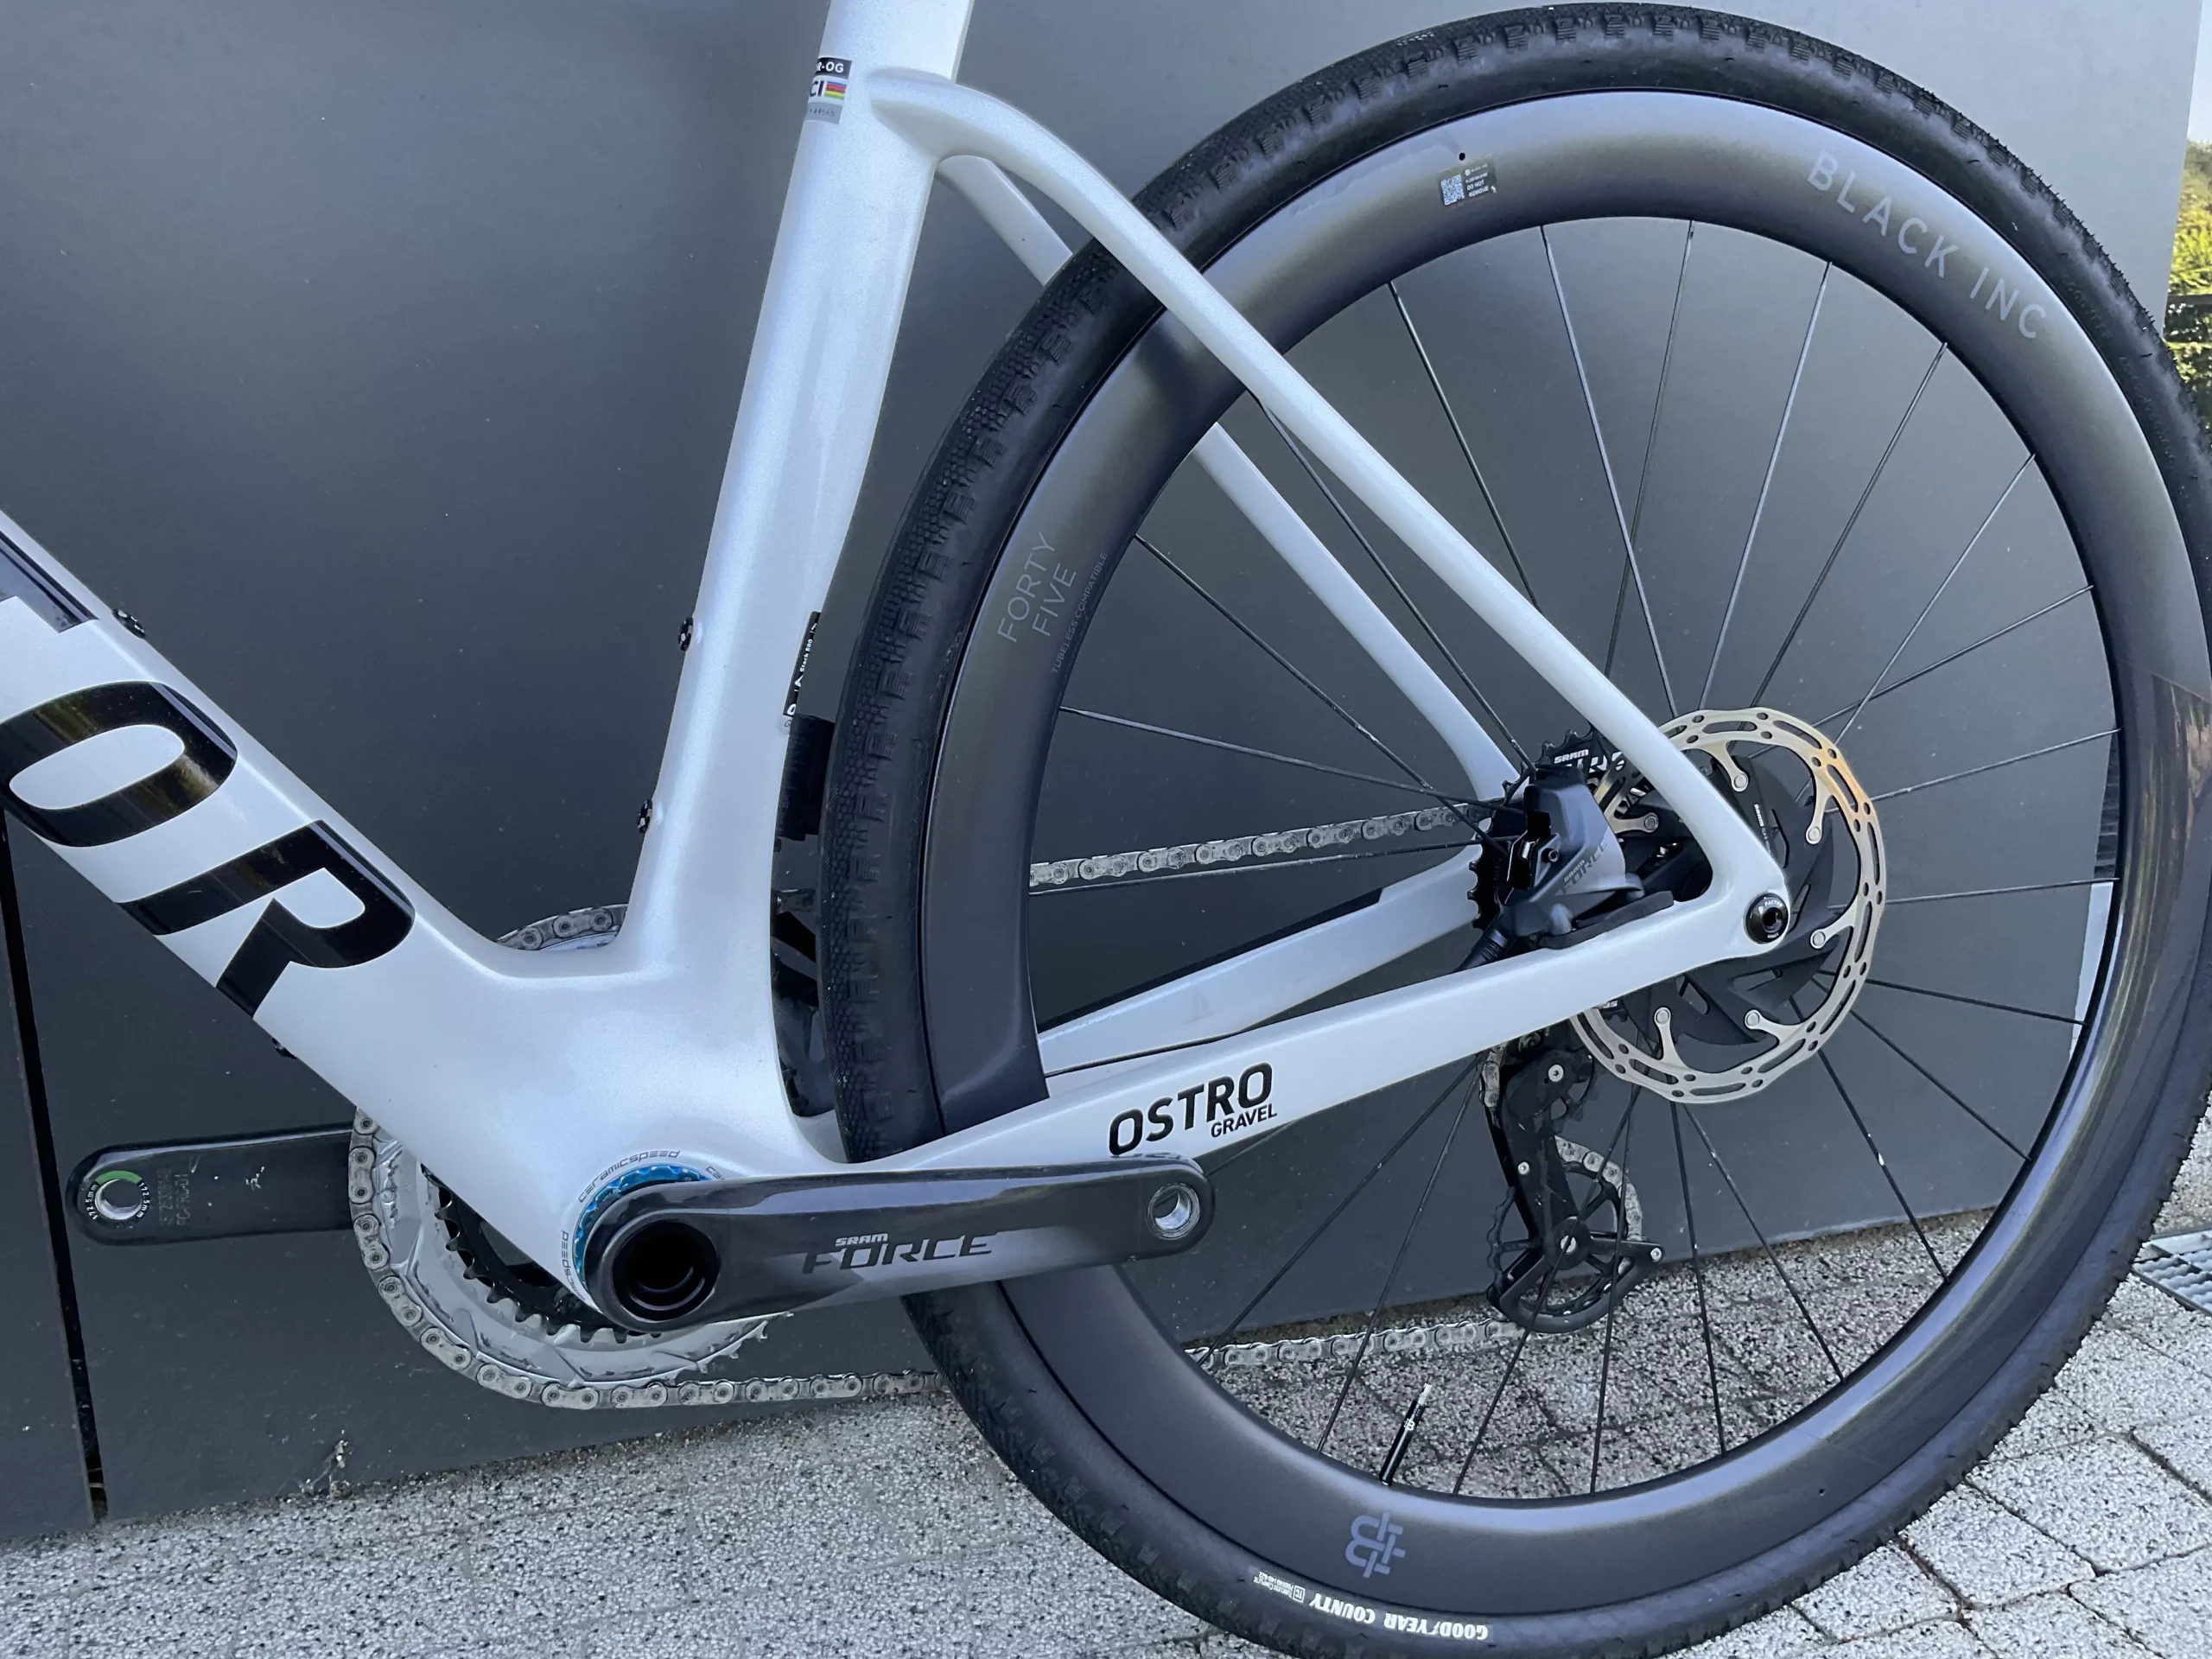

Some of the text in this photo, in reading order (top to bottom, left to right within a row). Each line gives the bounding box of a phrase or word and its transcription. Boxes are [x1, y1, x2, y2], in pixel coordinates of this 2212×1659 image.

[1808, 149, 2046, 339] BLACK INC
[997, 531, 1055, 643] FORTY
[1032, 563, 1077, 637] FIVE
[1052, 551, 1108, 673] TUBELESS COMPATIBLE
[1554, 748, 1589, 764] SRAM
[1561, 842, 1607, 894] FORCE
[1564, 860, 1585, 881] SRAM
[1109, 1062, 1273, 1155] OSTRO
[1211, 1103, 1277, 1138] GRAVEL
[802, 1236, 992, 1274] FORCE
[835, 1233, 888, 1247] SRAM
[1309, 1592, 1376, 1624] COUNTY
